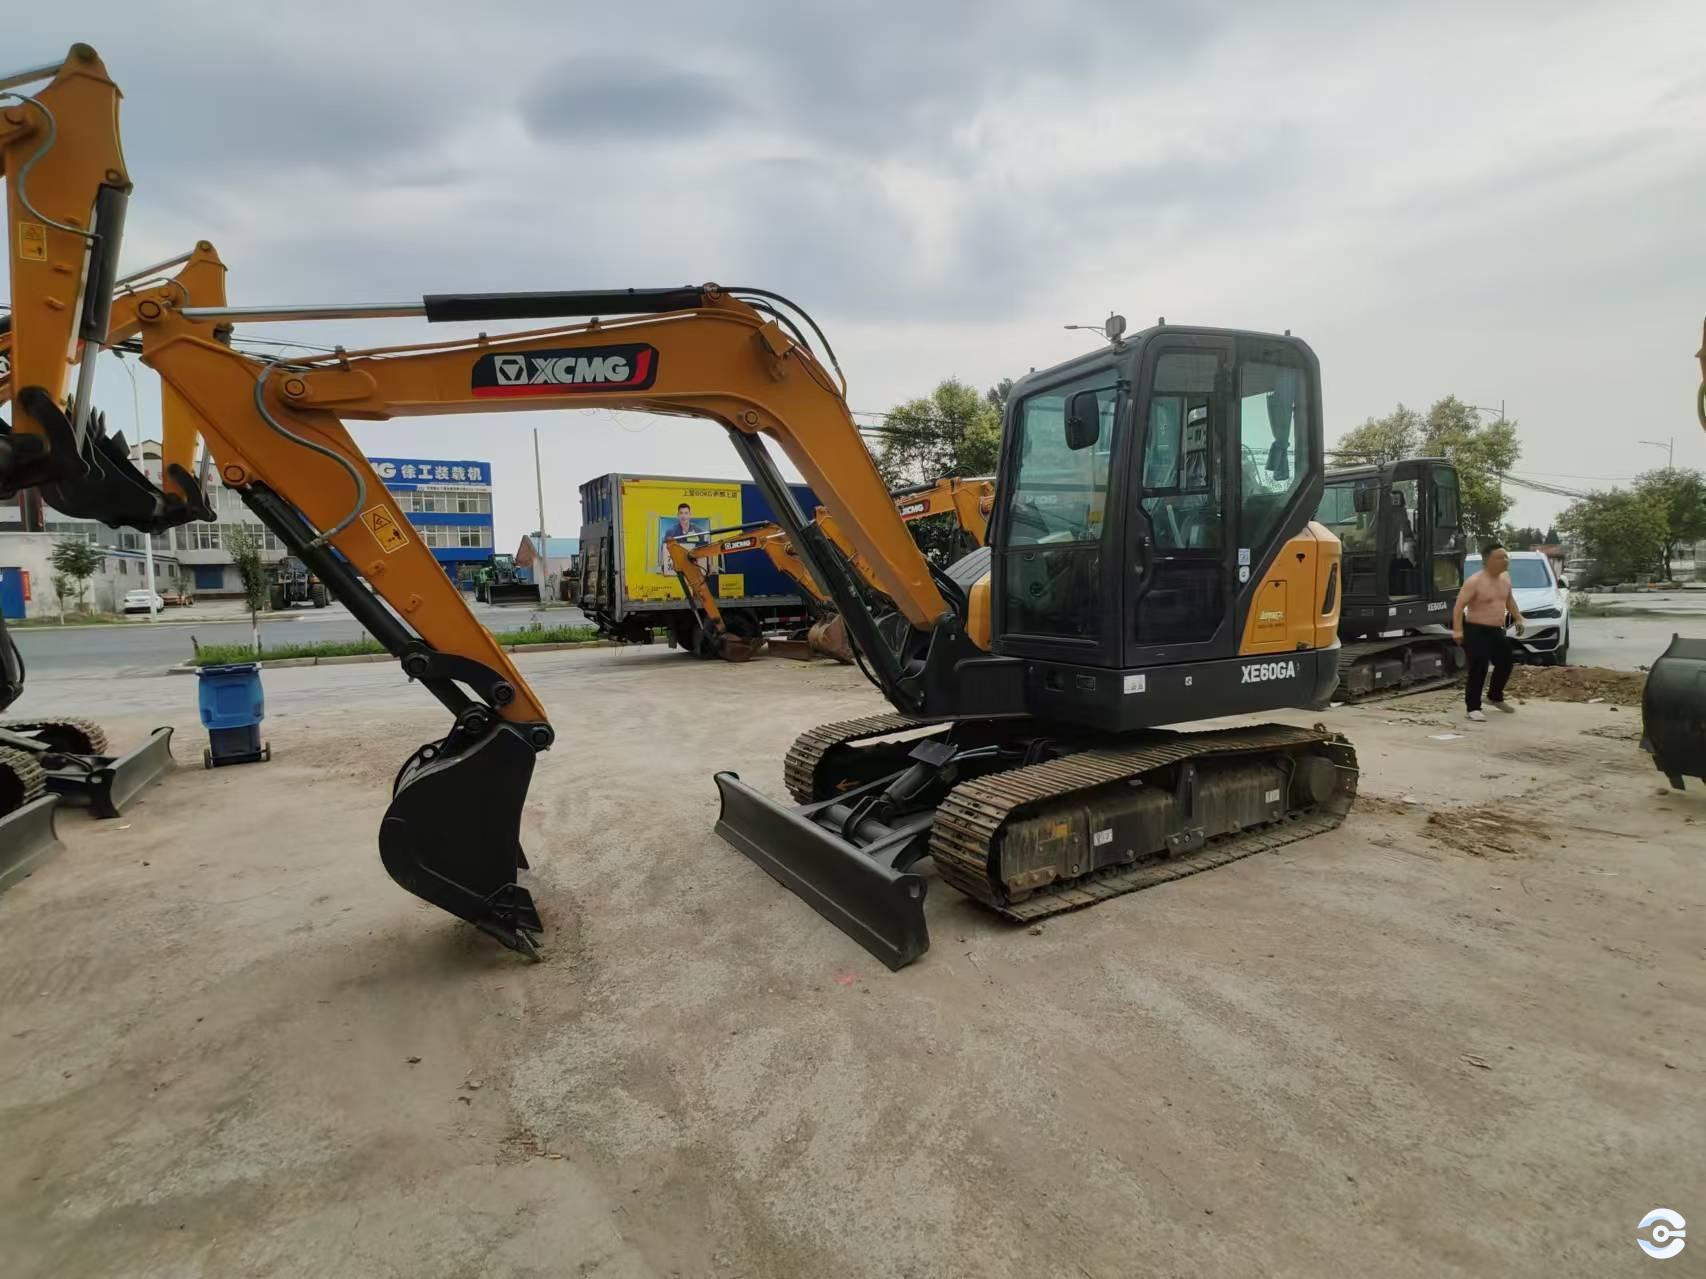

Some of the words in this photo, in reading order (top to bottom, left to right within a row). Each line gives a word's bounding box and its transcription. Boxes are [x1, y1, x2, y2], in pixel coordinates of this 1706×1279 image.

[529, 355, 630, 385] XCMG
[401, 464, 482, 481] 徐工装载机
[1241, 660, 1296, 683] XE60GA
